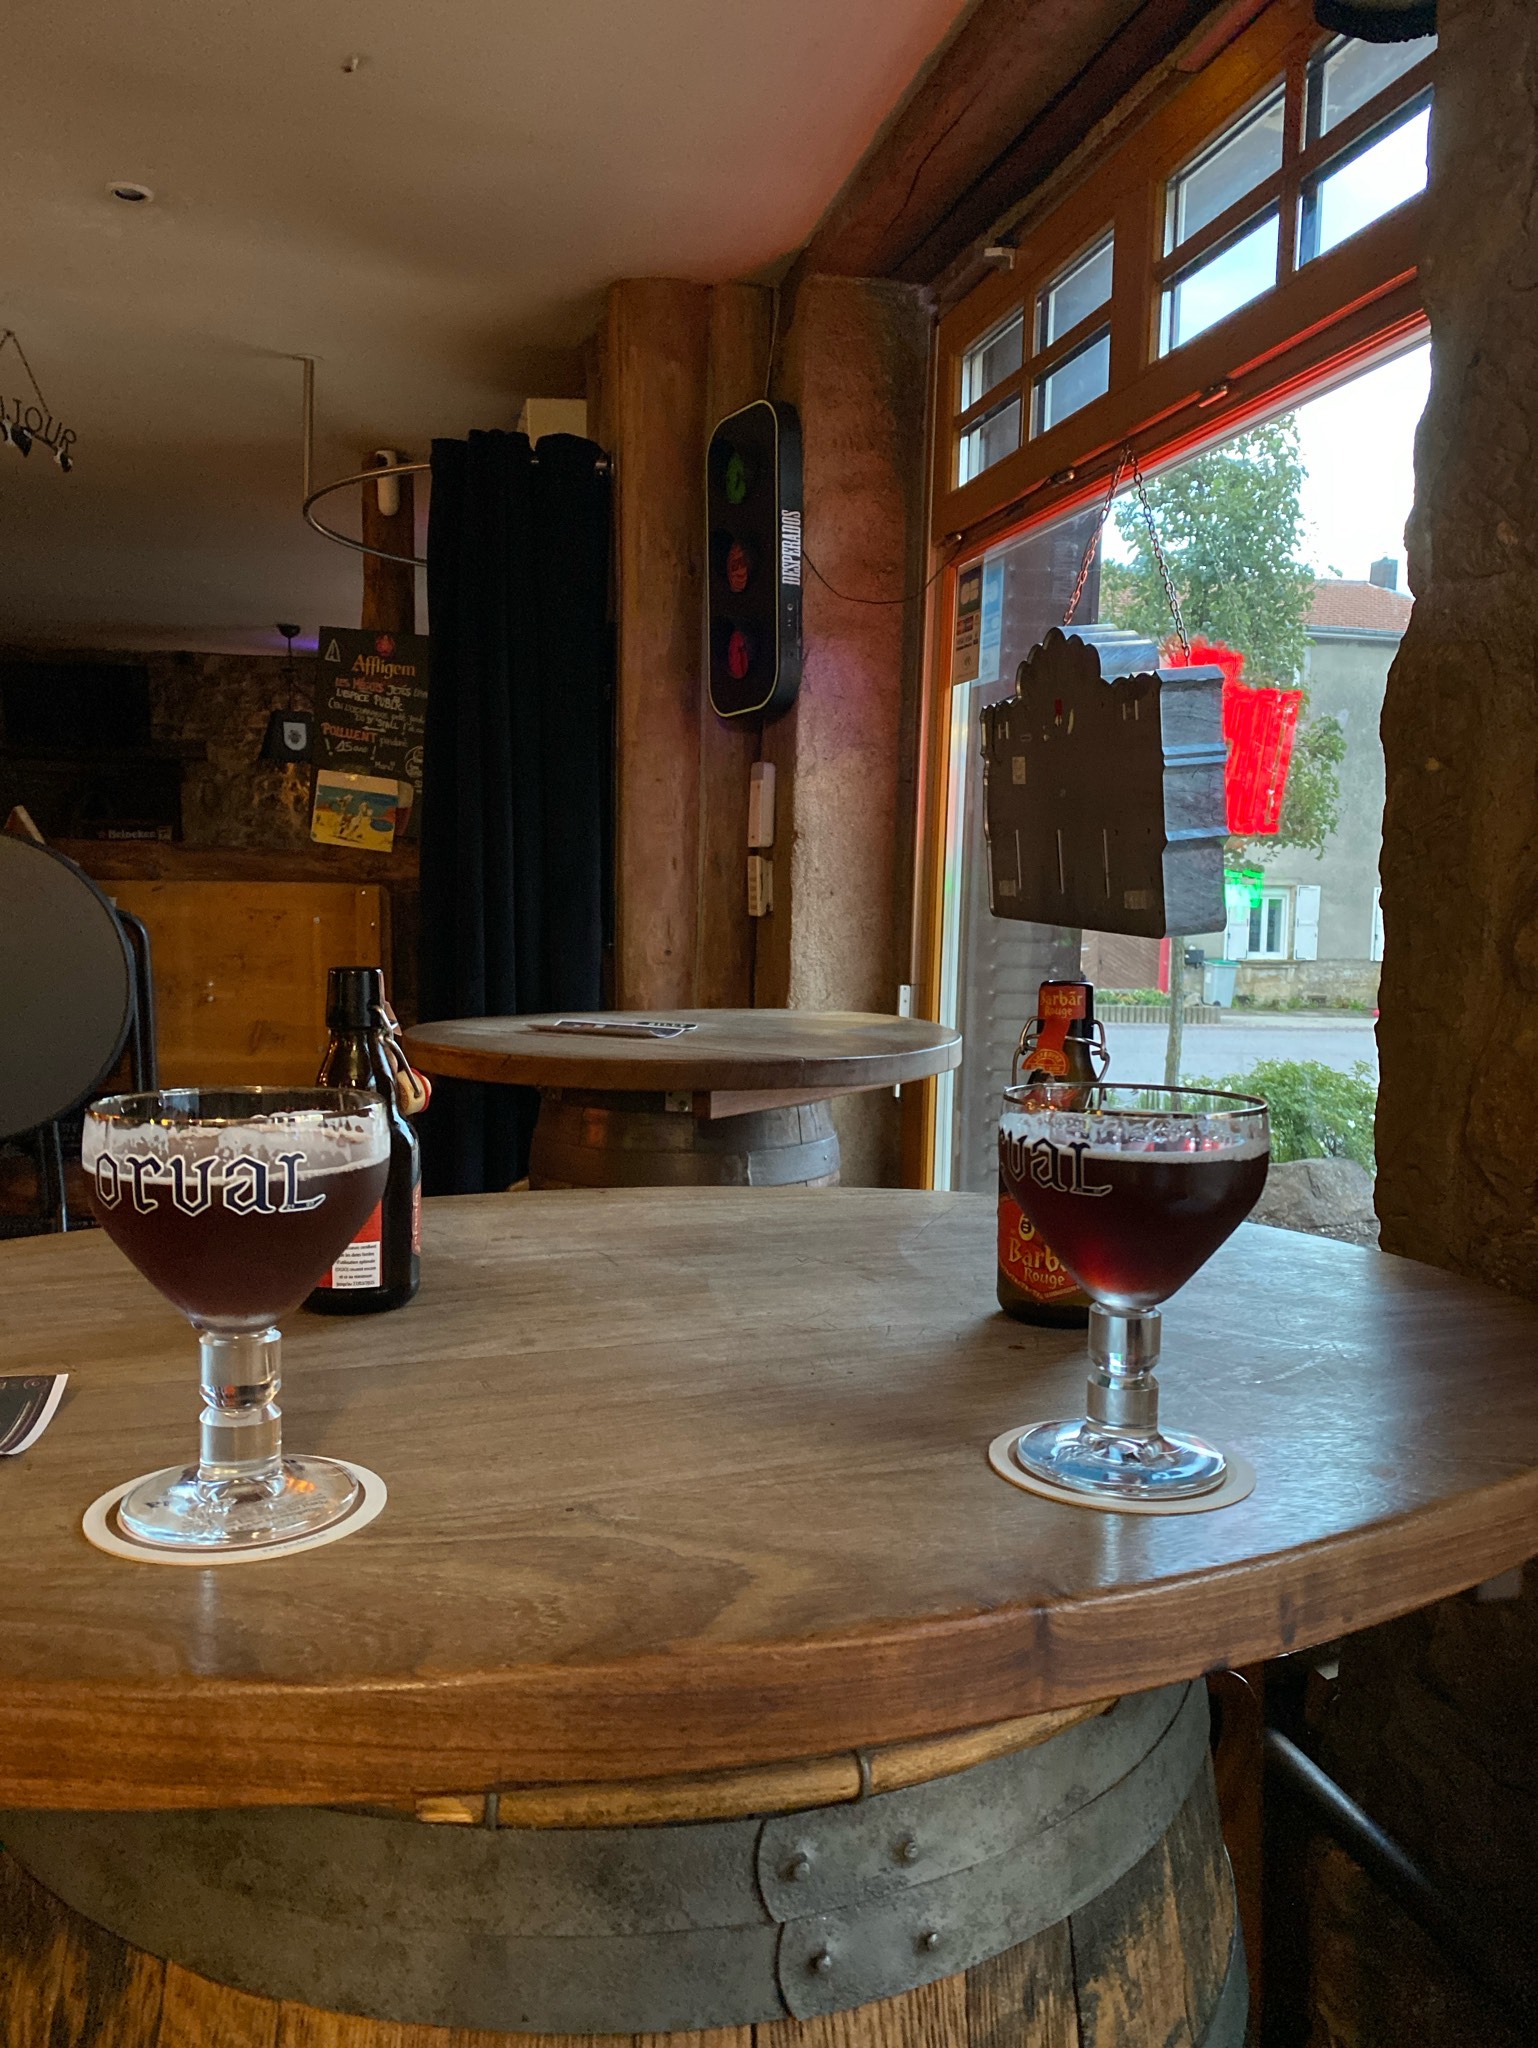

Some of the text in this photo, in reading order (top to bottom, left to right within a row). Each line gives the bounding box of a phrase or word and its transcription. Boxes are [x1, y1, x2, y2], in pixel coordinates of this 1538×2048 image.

[0, 396, 77, 462] JOUR
[781, 509, 801, 586] DESPERADOS
[351, 654, 417, 679] Affligem
[1044, 1006, 1073, 1019] Rouge
[1024, 1267, 1065, 1289] Rouge
